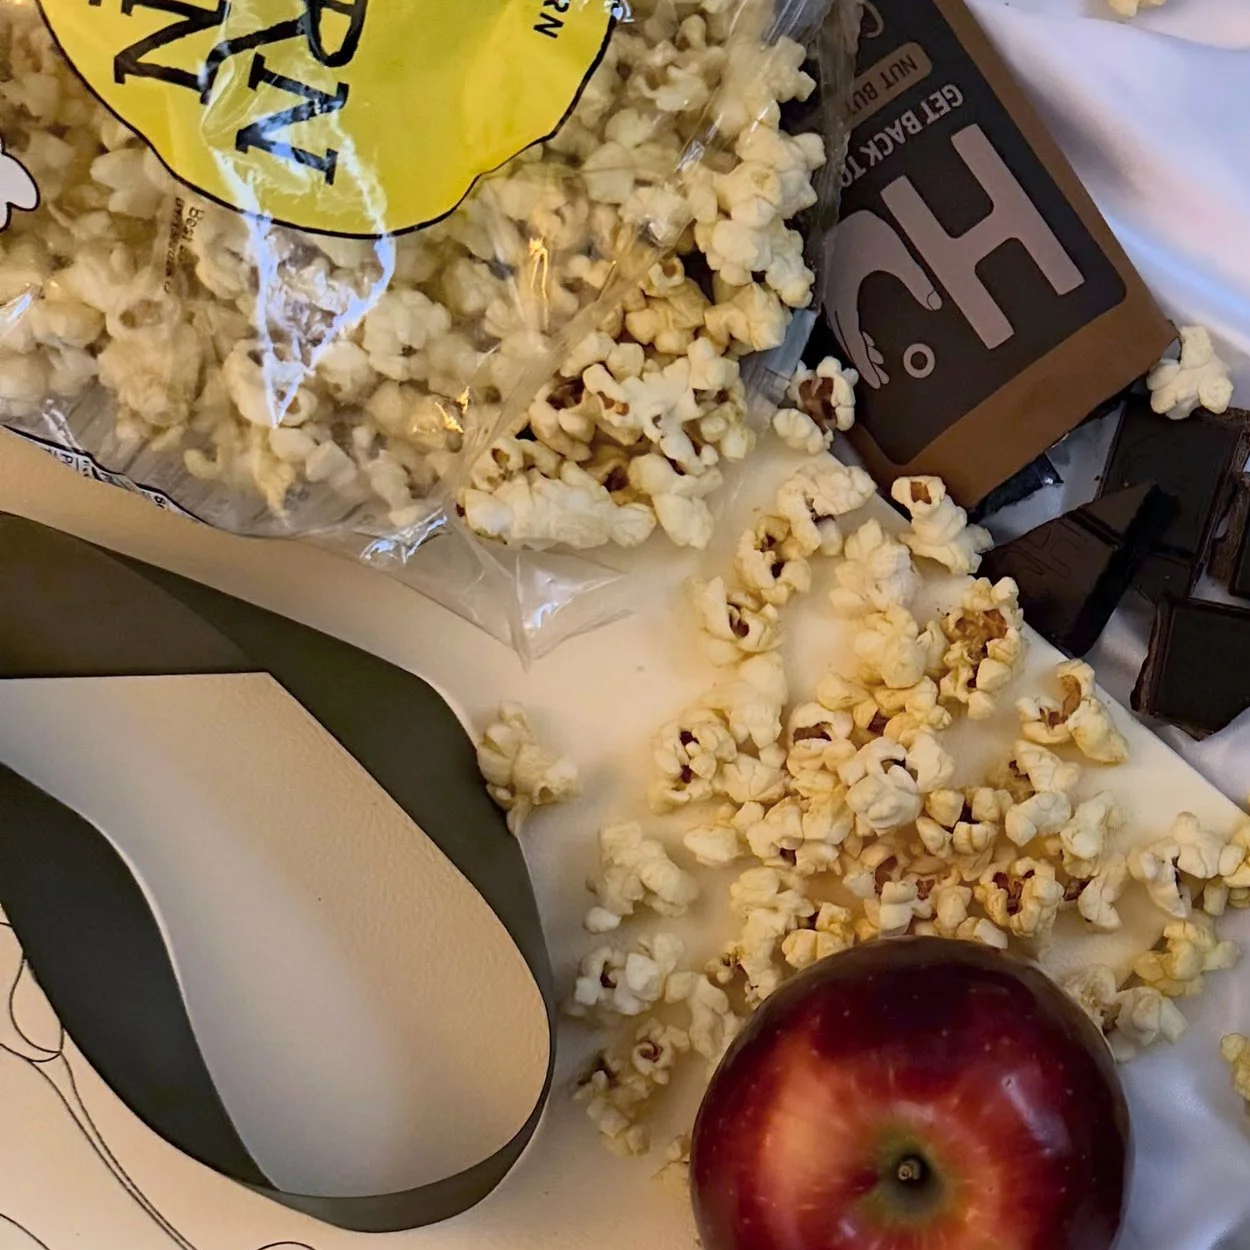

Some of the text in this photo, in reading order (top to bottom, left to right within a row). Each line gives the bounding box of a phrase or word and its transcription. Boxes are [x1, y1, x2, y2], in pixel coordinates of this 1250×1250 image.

[879, 54, 919, 91] NUT
[919, 84, 964, 126] GET
[859, 109, 923, 167] BACK
